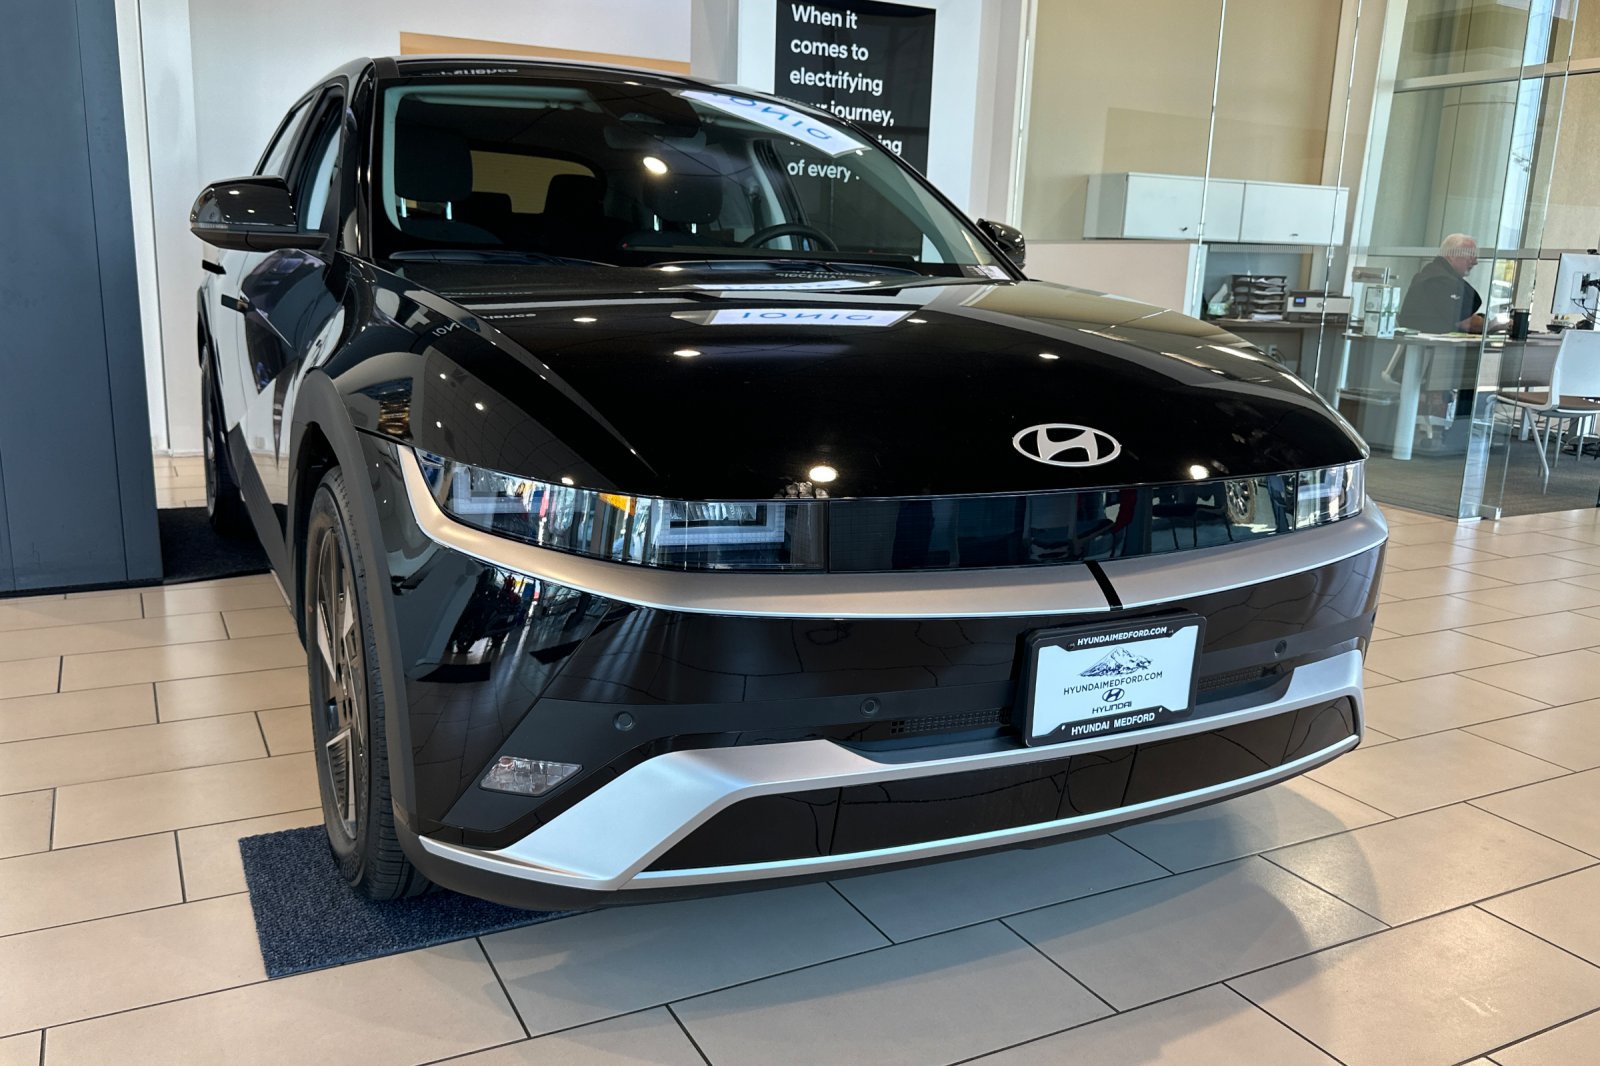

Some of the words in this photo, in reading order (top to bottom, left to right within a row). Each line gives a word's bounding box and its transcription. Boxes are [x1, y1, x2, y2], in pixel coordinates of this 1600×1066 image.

[791, 4, 842, 27] When
[846, 10, 858, 29] it
[790, 39, 848, 58] comes
[851, 43, 869, 61] to
[789, 67, 883, 96] electrifying
[830, 101, 894, 126] journey,
[787, 159, 805, 176] of
[1077, 626, 1168, 646] HYUNDAIMEDFORD.COM
[1063, 671, 1163, 695] HYUNDAIMEDFORD.COM
[1091, 701, 1133, 714] HYUNDAI
[1071, 720, 1110, 736] HYUNDAI
[1113, 712, 1155, 728] MEDFORD
